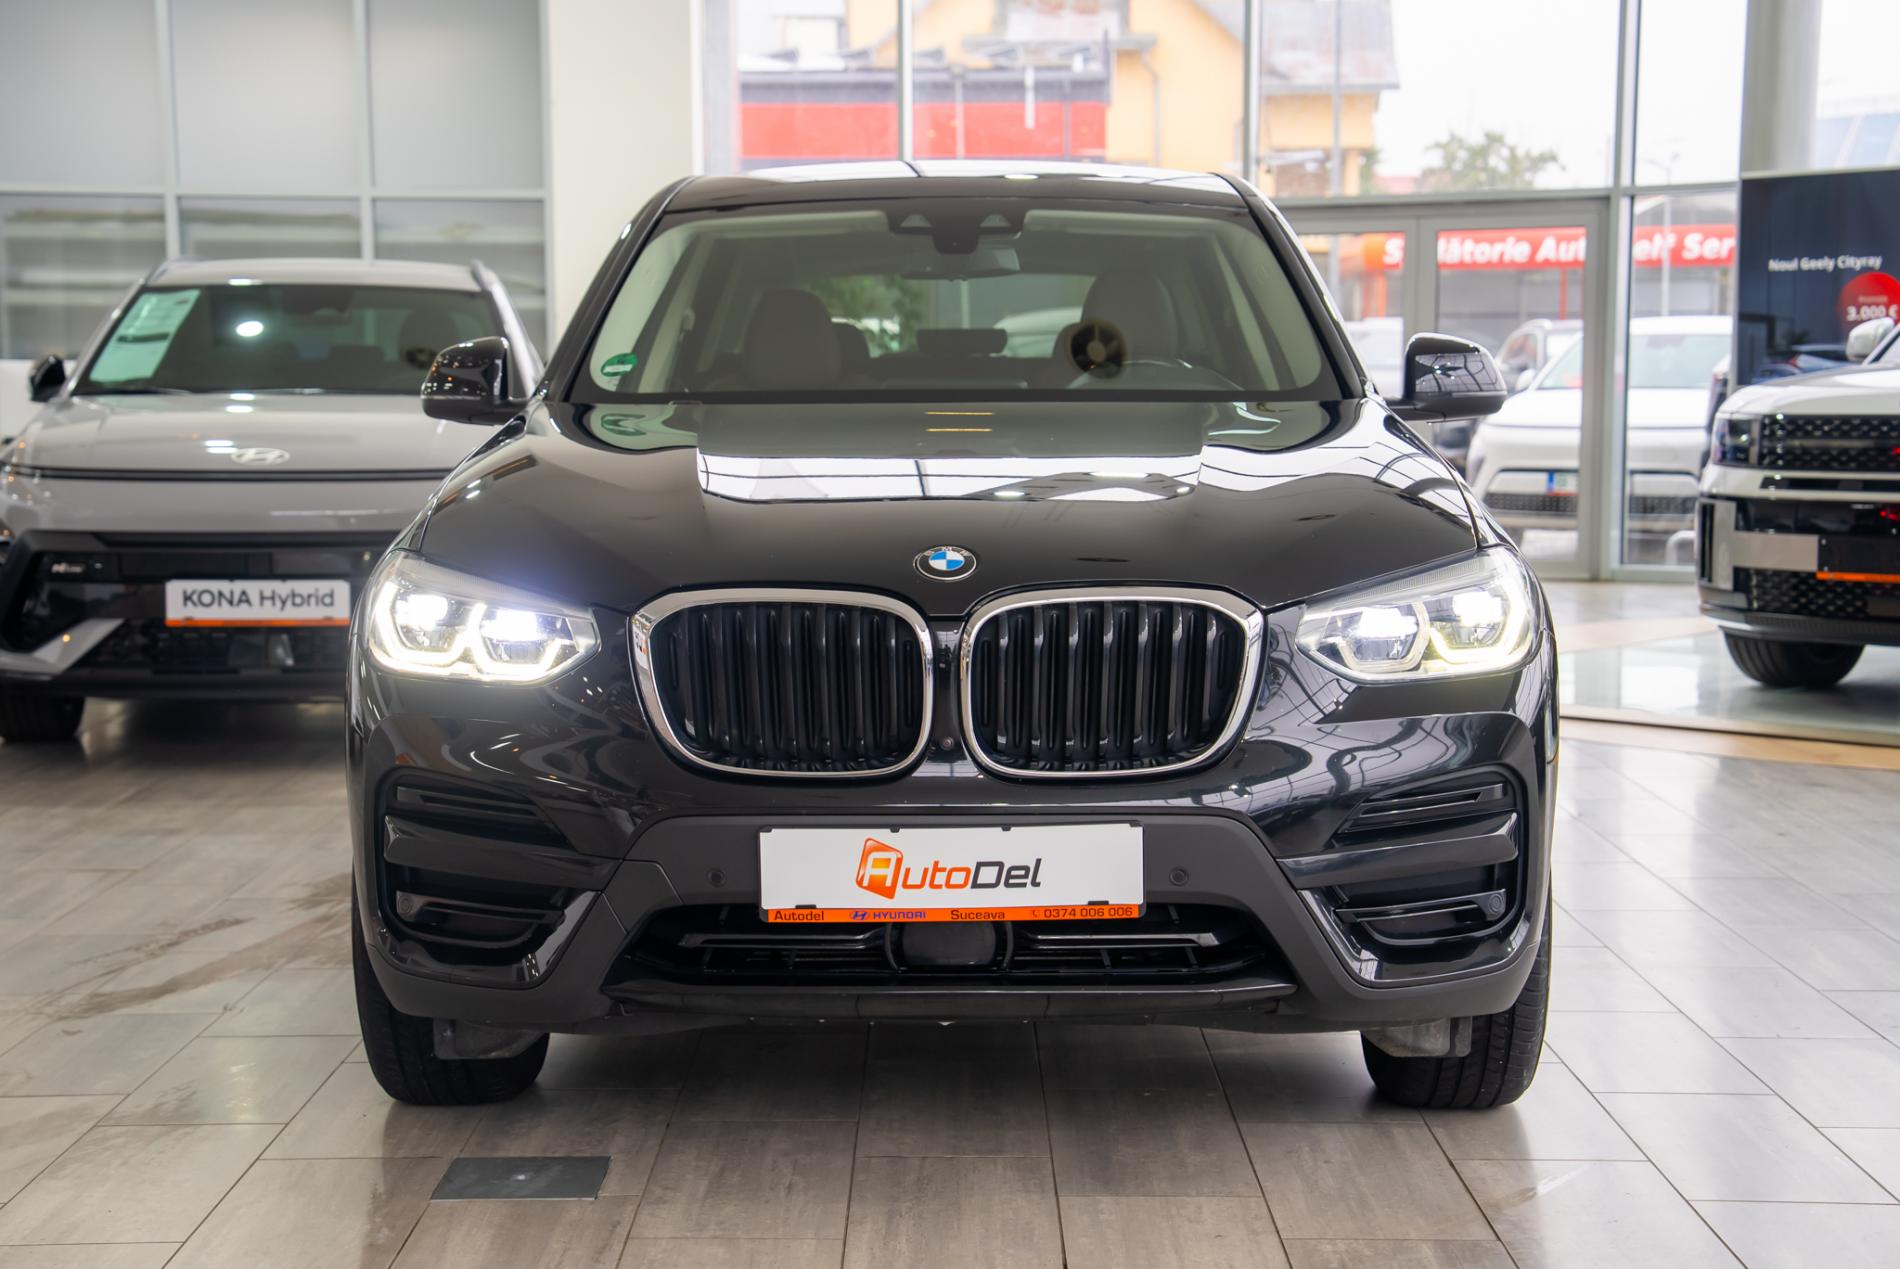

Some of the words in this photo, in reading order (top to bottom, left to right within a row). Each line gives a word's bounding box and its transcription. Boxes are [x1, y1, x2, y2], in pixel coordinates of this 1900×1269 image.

[1535, 234, 1587, 263] Aut
[1632, 232, 1677, 260] elf
[1800, 256, 1835, 272] Geely
[1837, 254, 1882, 271] Cityray
[182, 589, 252, 608] KONA
[259, 588, 335, 611] Hybrid
[858, 845, 1042, 892] AutoDel
[774, 910, 825, 921] Autodel
[872, 911, 926, 919] HYUNDAI
[950, 909, 1005, 920] Suceava
[1043, 908, 1076, 918] 0374
[1080, 907, 1104, 918] 006
[1108, 906, 1133, 917] 006
